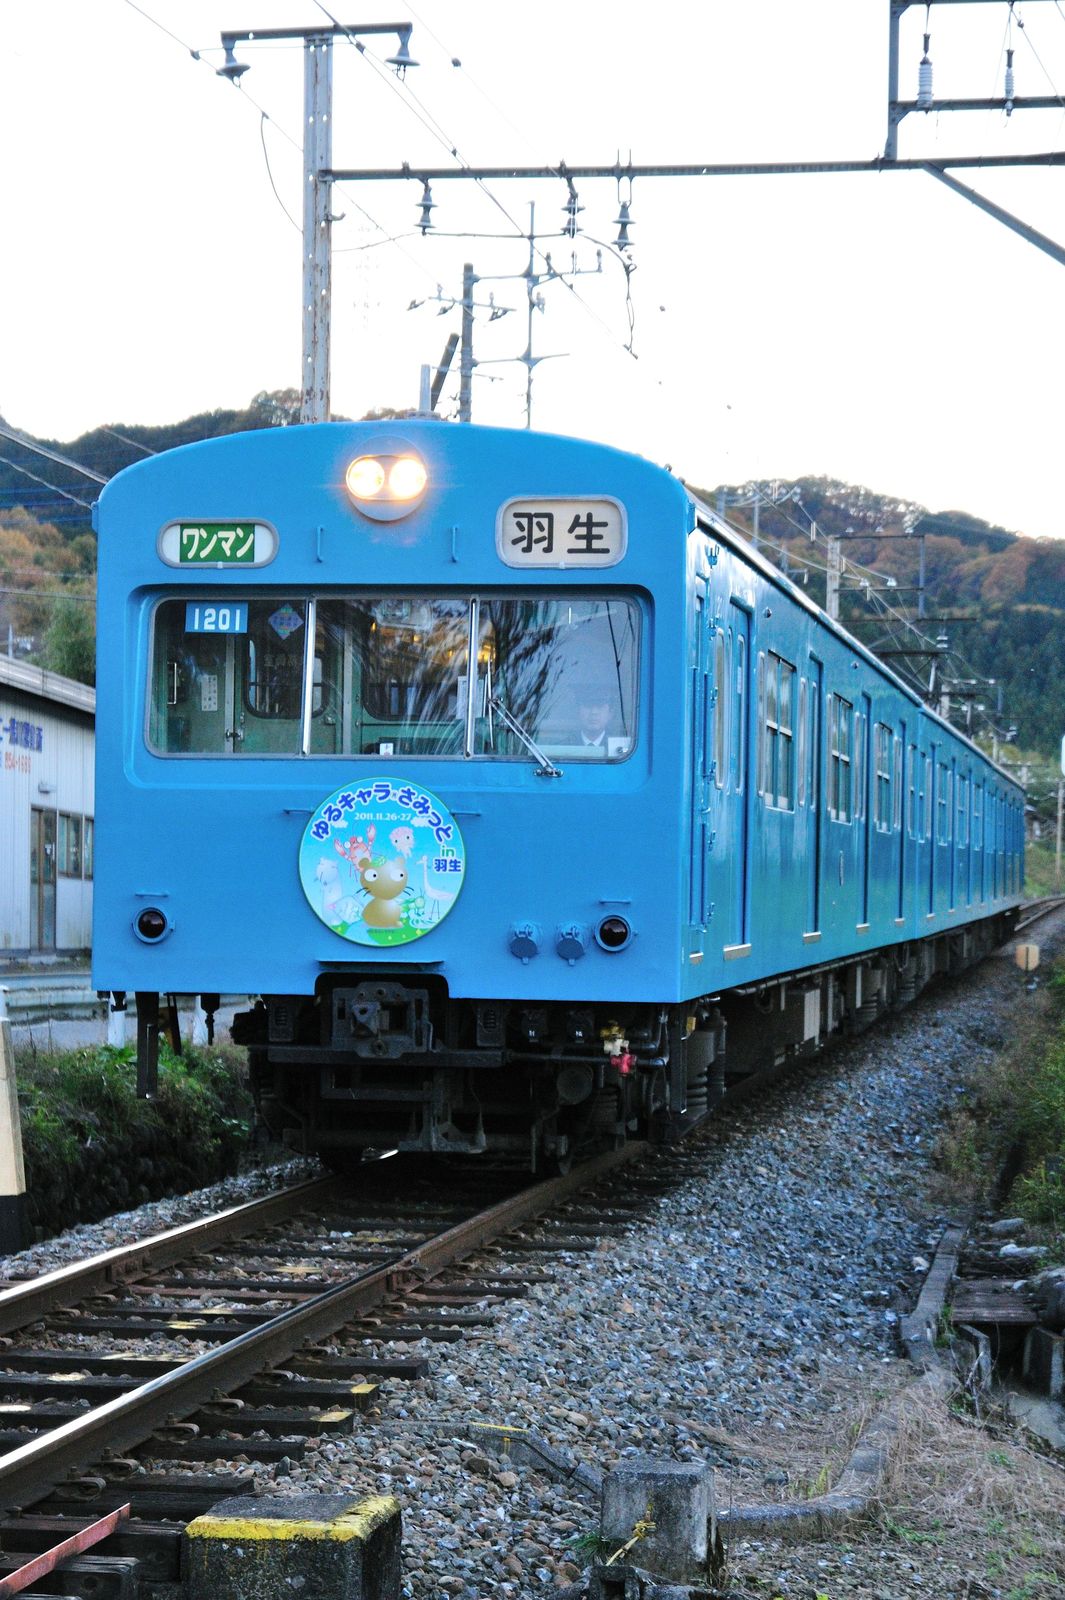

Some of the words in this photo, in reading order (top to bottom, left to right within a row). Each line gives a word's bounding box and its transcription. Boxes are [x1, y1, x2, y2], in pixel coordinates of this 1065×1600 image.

[182, 528, 254, 559] ワンマン
[511, 512, 610, 554] 羽生
[194, 608, 241, 631] 1201
[441, 845, 455, 857] in
[434, 859, 462, 872] 羽生
